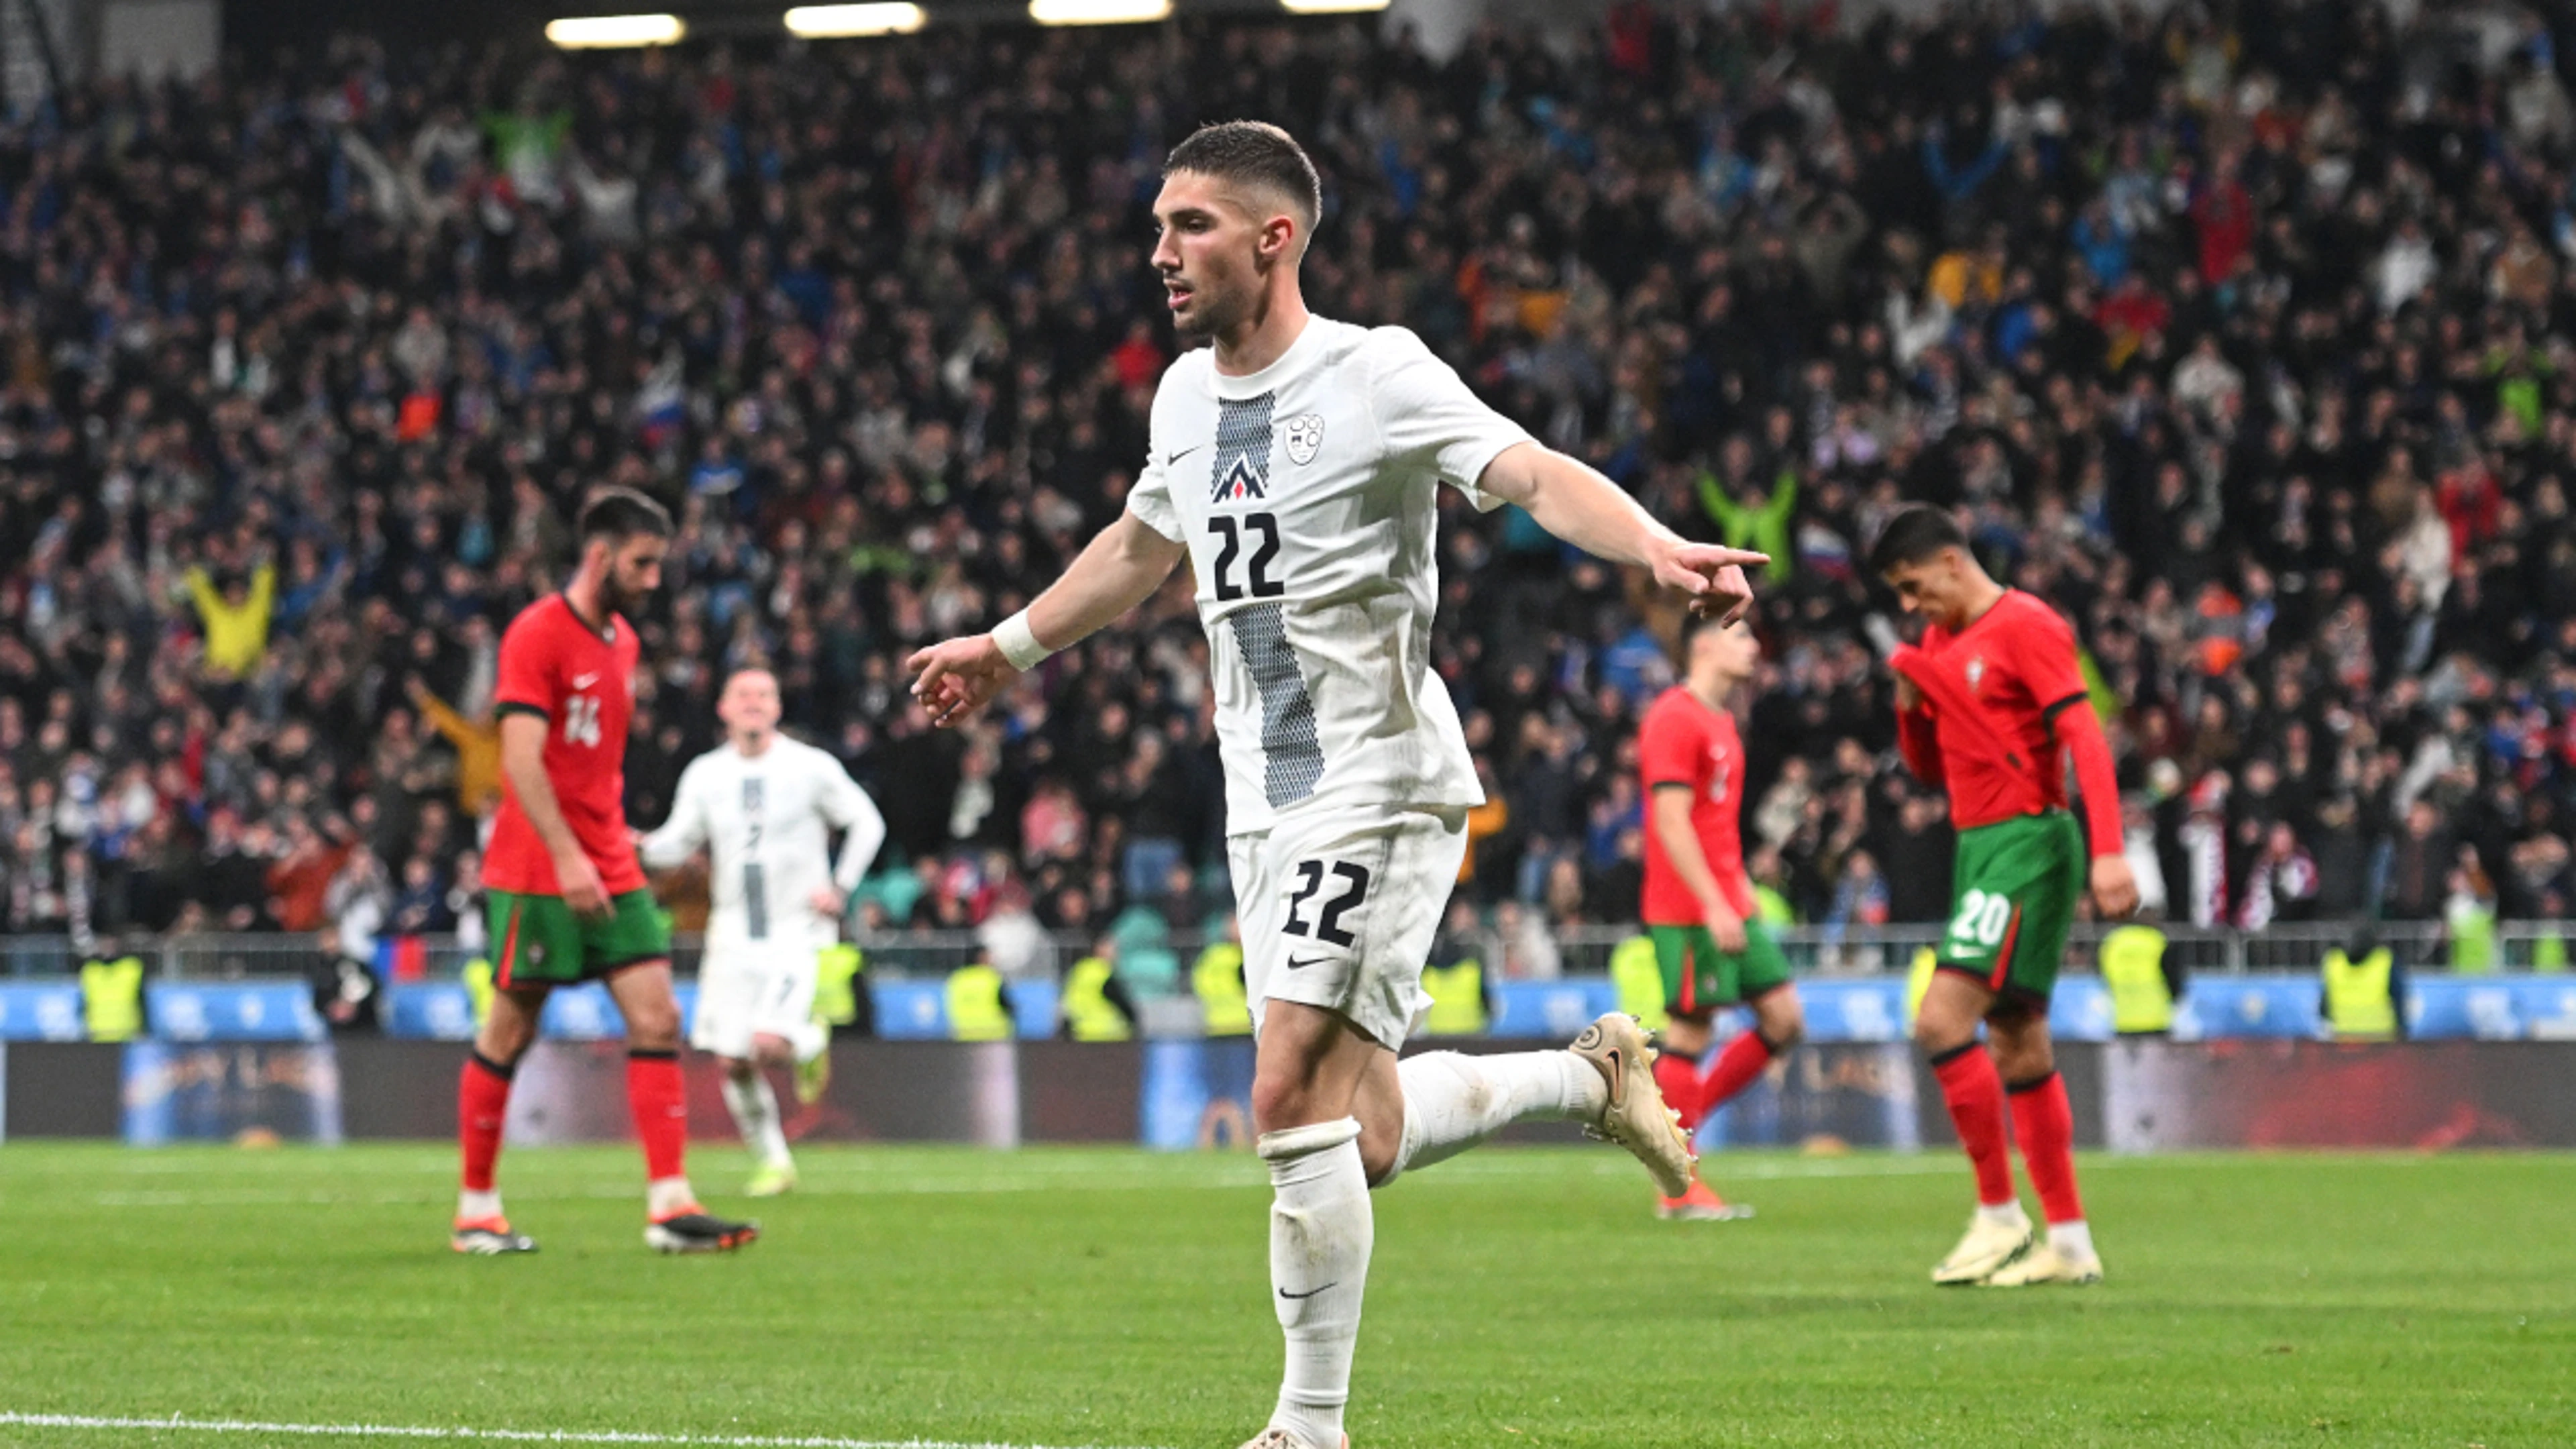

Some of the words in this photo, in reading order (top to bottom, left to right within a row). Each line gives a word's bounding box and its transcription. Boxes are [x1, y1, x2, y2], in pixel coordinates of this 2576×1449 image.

[1208, 512, 1284, 601] 22
[1282, 859, 1370, 947] 22
[1949, 888, 2011, 945] 20
